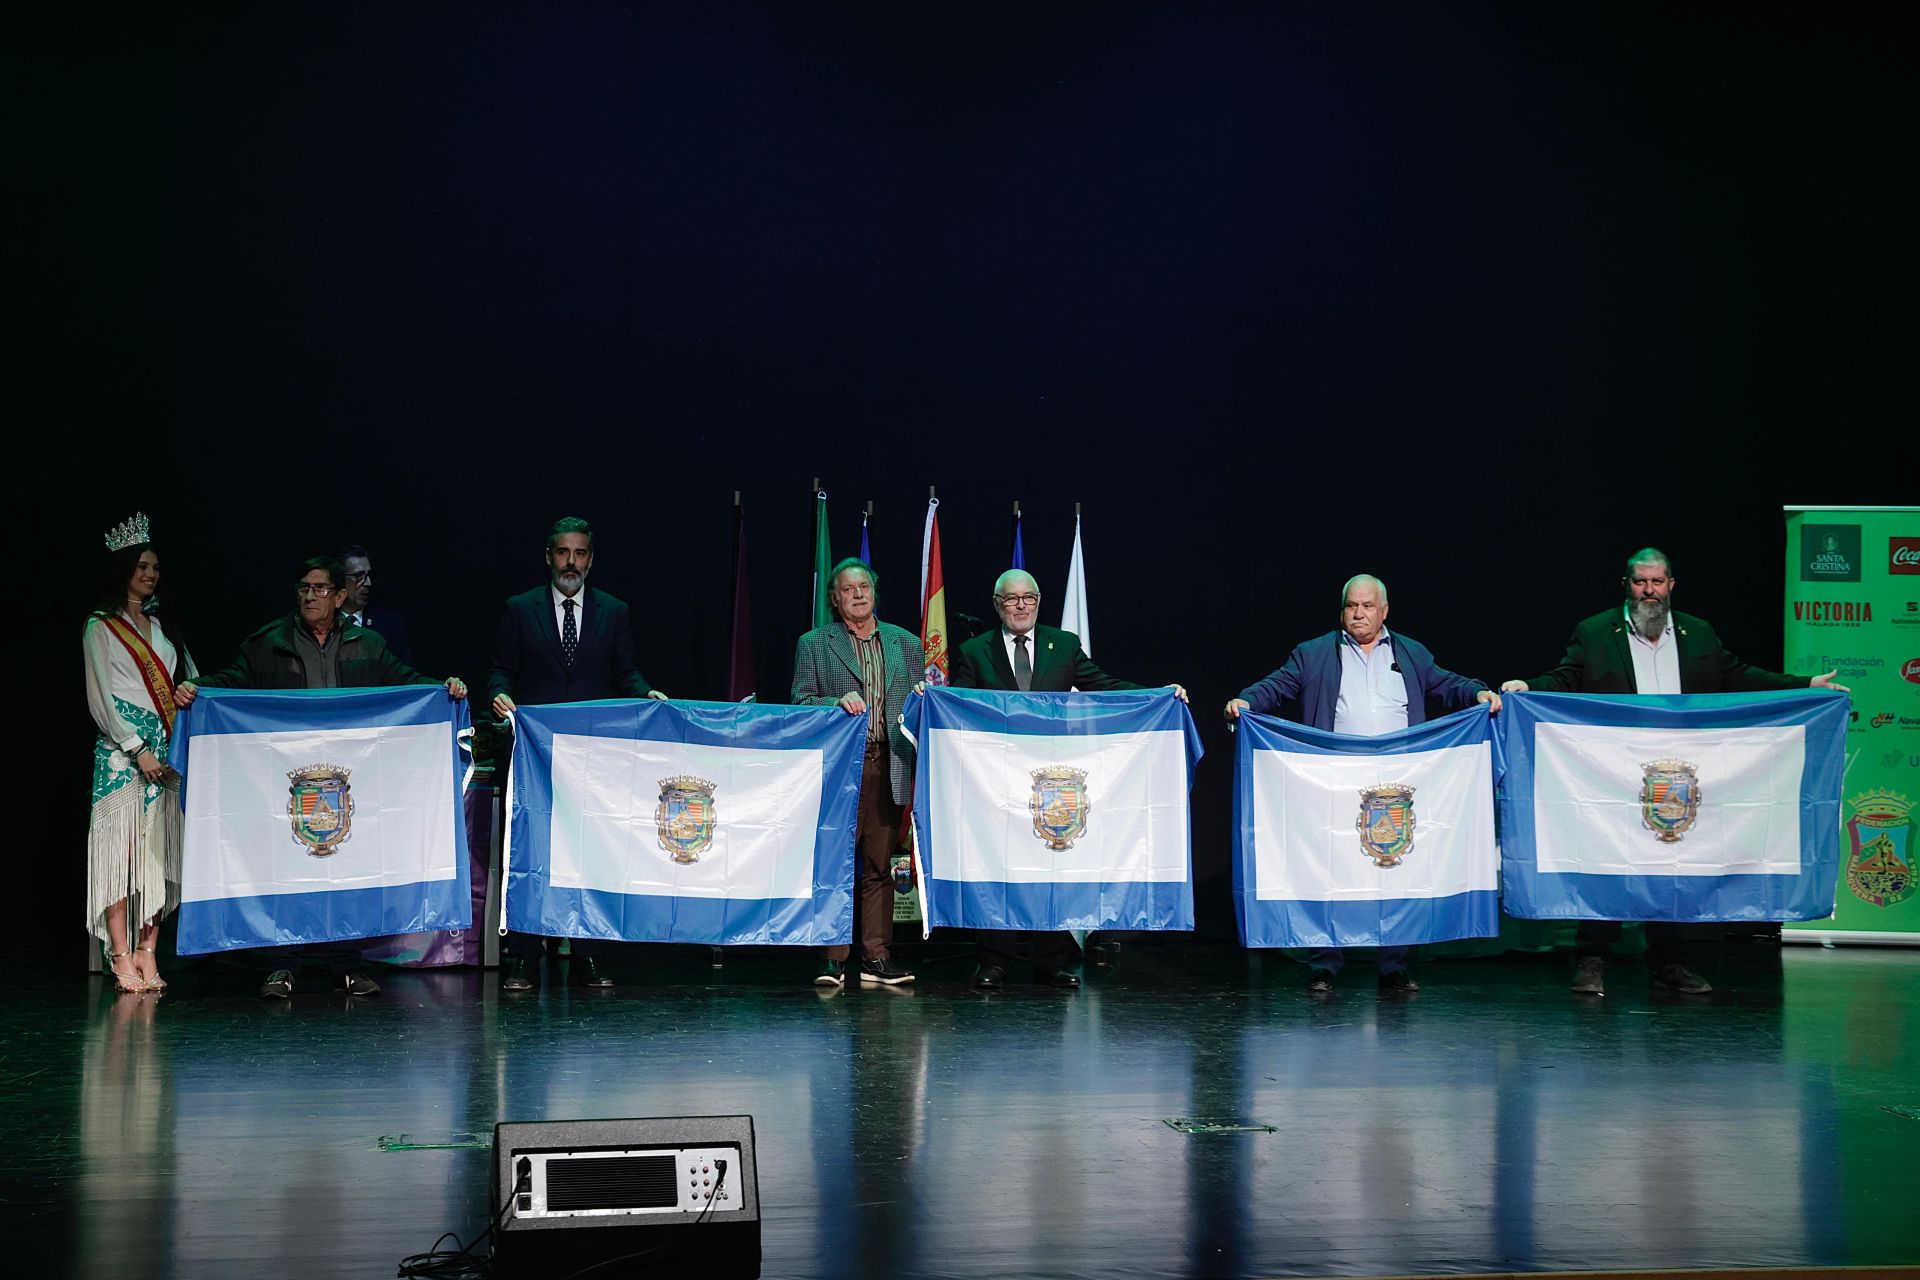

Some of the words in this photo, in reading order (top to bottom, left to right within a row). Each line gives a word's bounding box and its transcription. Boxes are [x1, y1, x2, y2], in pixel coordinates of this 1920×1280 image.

[1815, 554, 1846, 563] SANTA
[1810, 562, 1851, 571] CRISTINA
[1793, 601, 1873, 622] VICTORIA
[1822, 655, 1885, 667] Fundación
[1822, 667, 1867, 679] Ucaja
[144, 660, 159, 682] Reina
[155, 684, 170, 705] Feria
